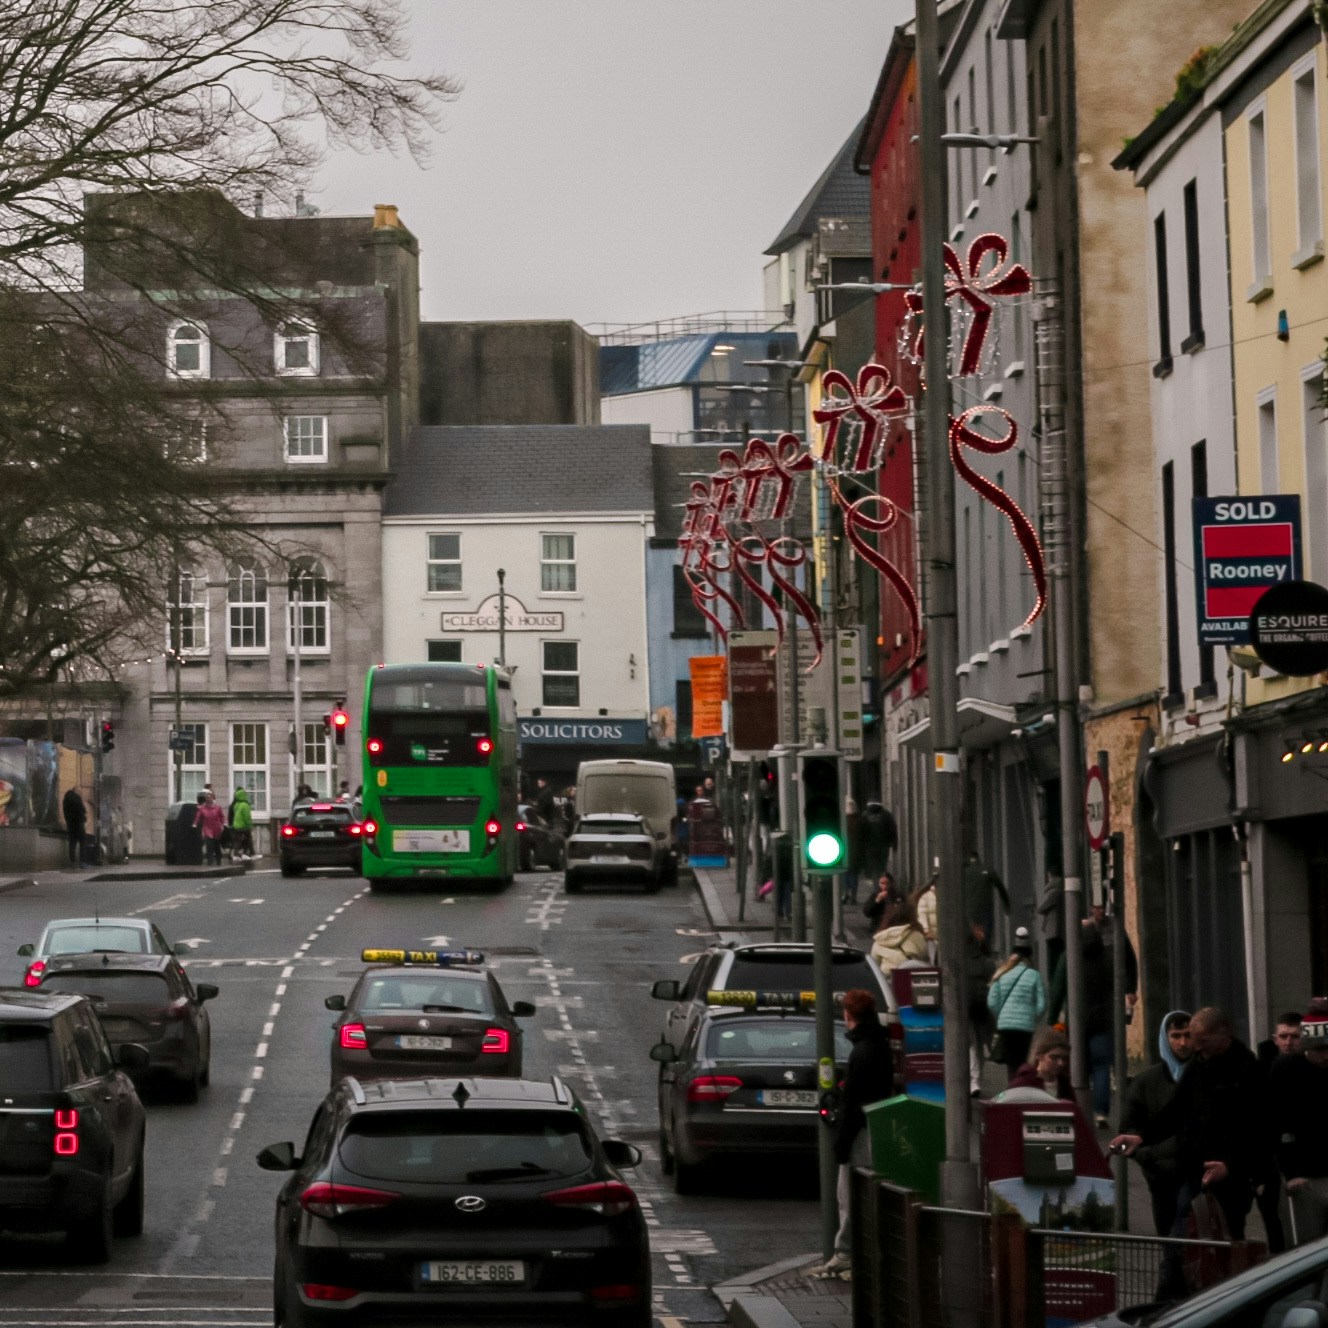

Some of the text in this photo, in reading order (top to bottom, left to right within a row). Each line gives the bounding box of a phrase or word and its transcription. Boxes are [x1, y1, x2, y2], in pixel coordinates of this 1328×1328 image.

[1215, 502, 1276, 521] SOLD
[1209, 563, 1287, 580] Rooney
[519, 616, 558, 626] HOUSE
[521, 723, 622, 739] SOLICITORS
[708, 748, 720, 764] P
[409, 951, 437, 961] TAXI
[763, 992, 794, 1003] TAXI
[437, 1265, 515, 1281] 162-CE-886
